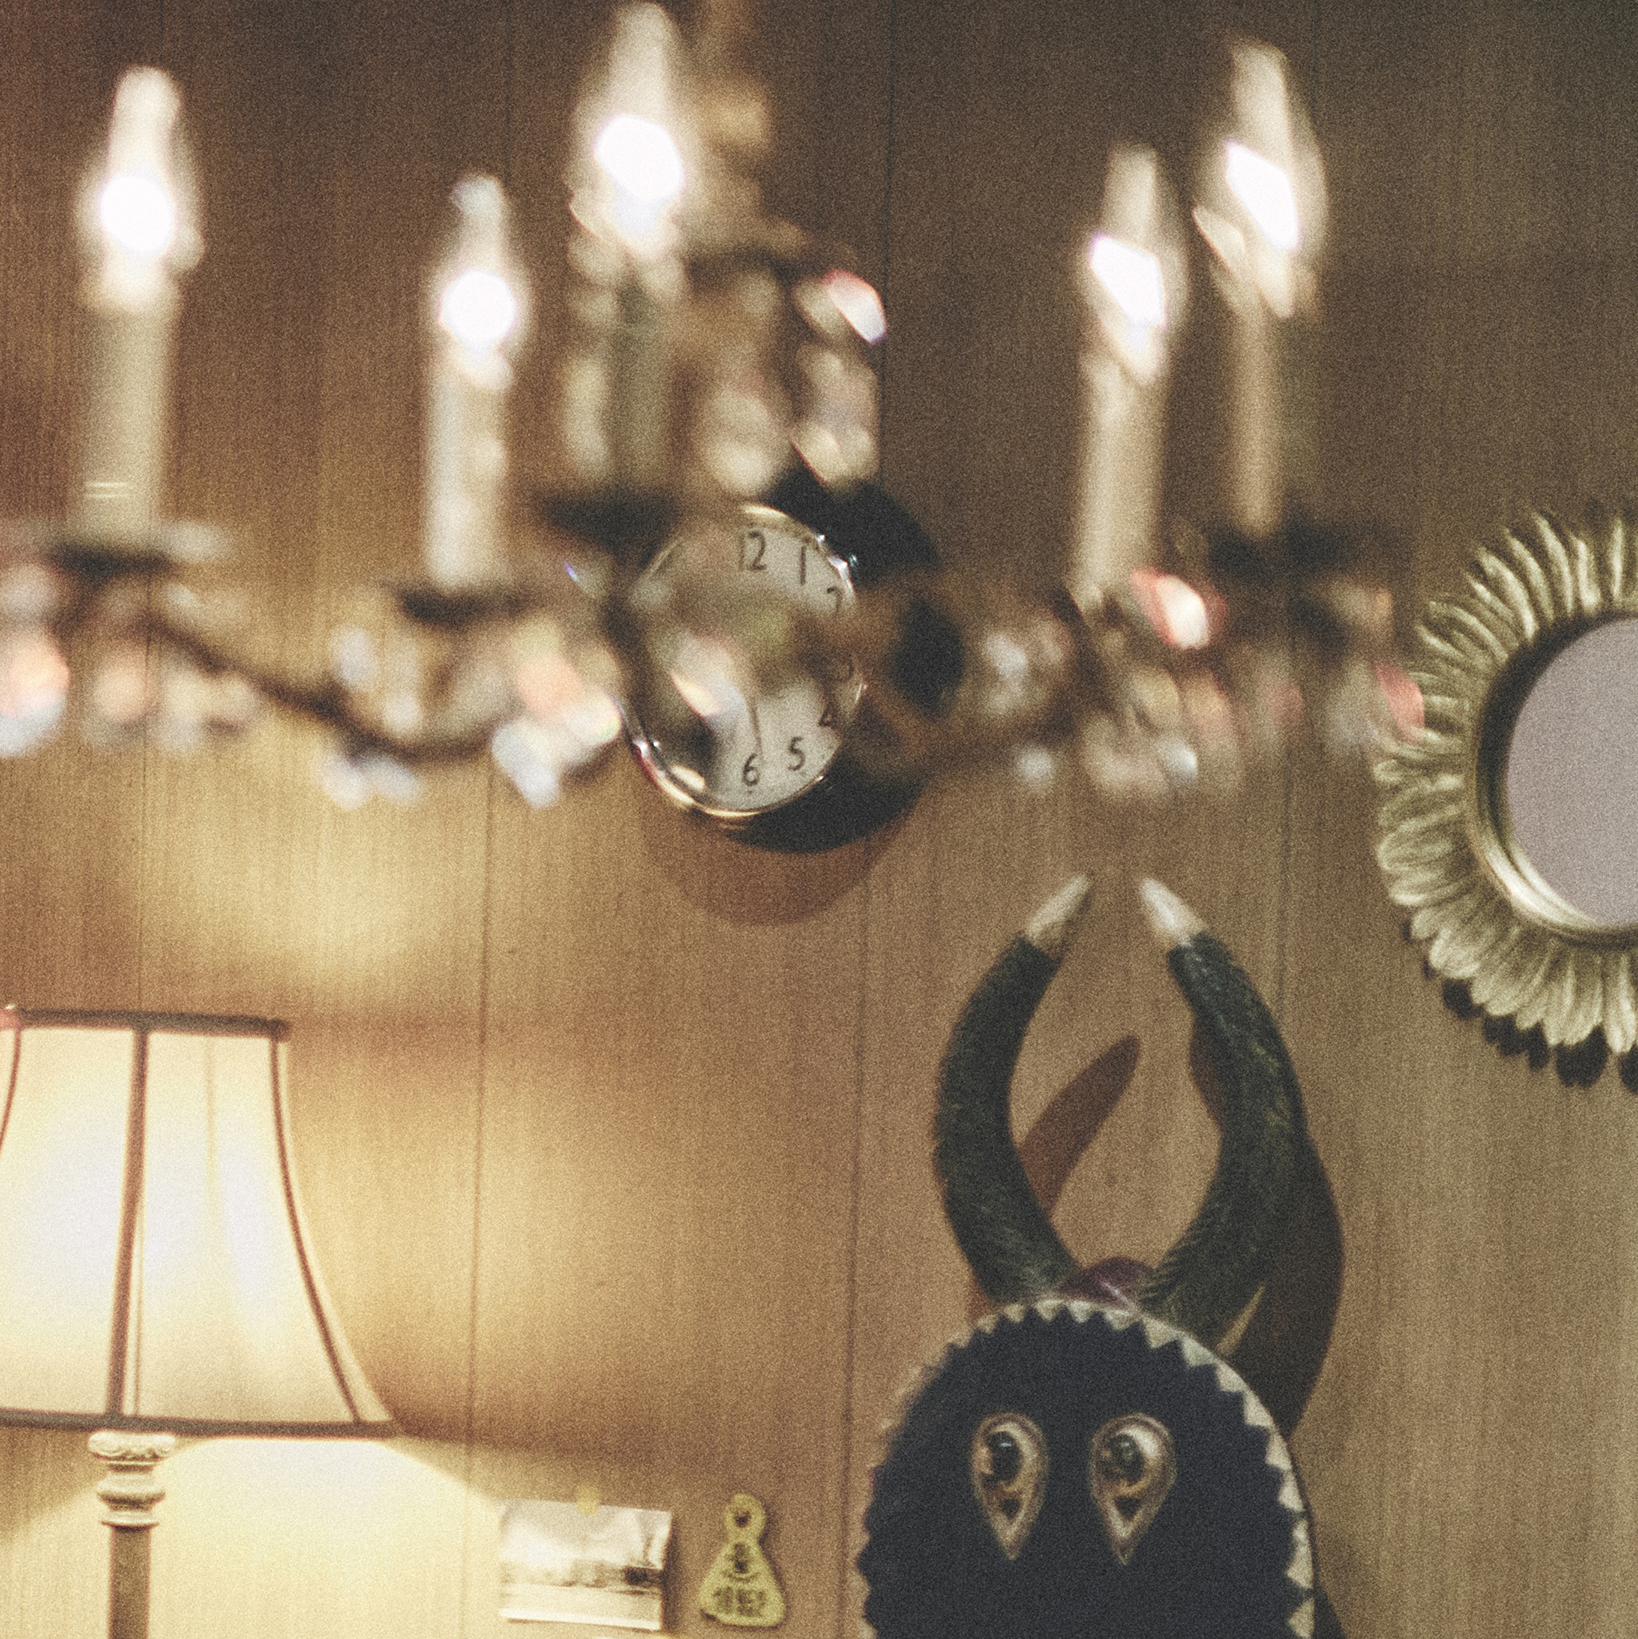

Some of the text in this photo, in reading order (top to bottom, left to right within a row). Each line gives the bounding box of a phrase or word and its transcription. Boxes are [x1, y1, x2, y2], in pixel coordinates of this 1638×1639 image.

[737, 530, 767, 572] 12
[741, 752, 761, 787] 6
[787, 736, 806, 772] 5
